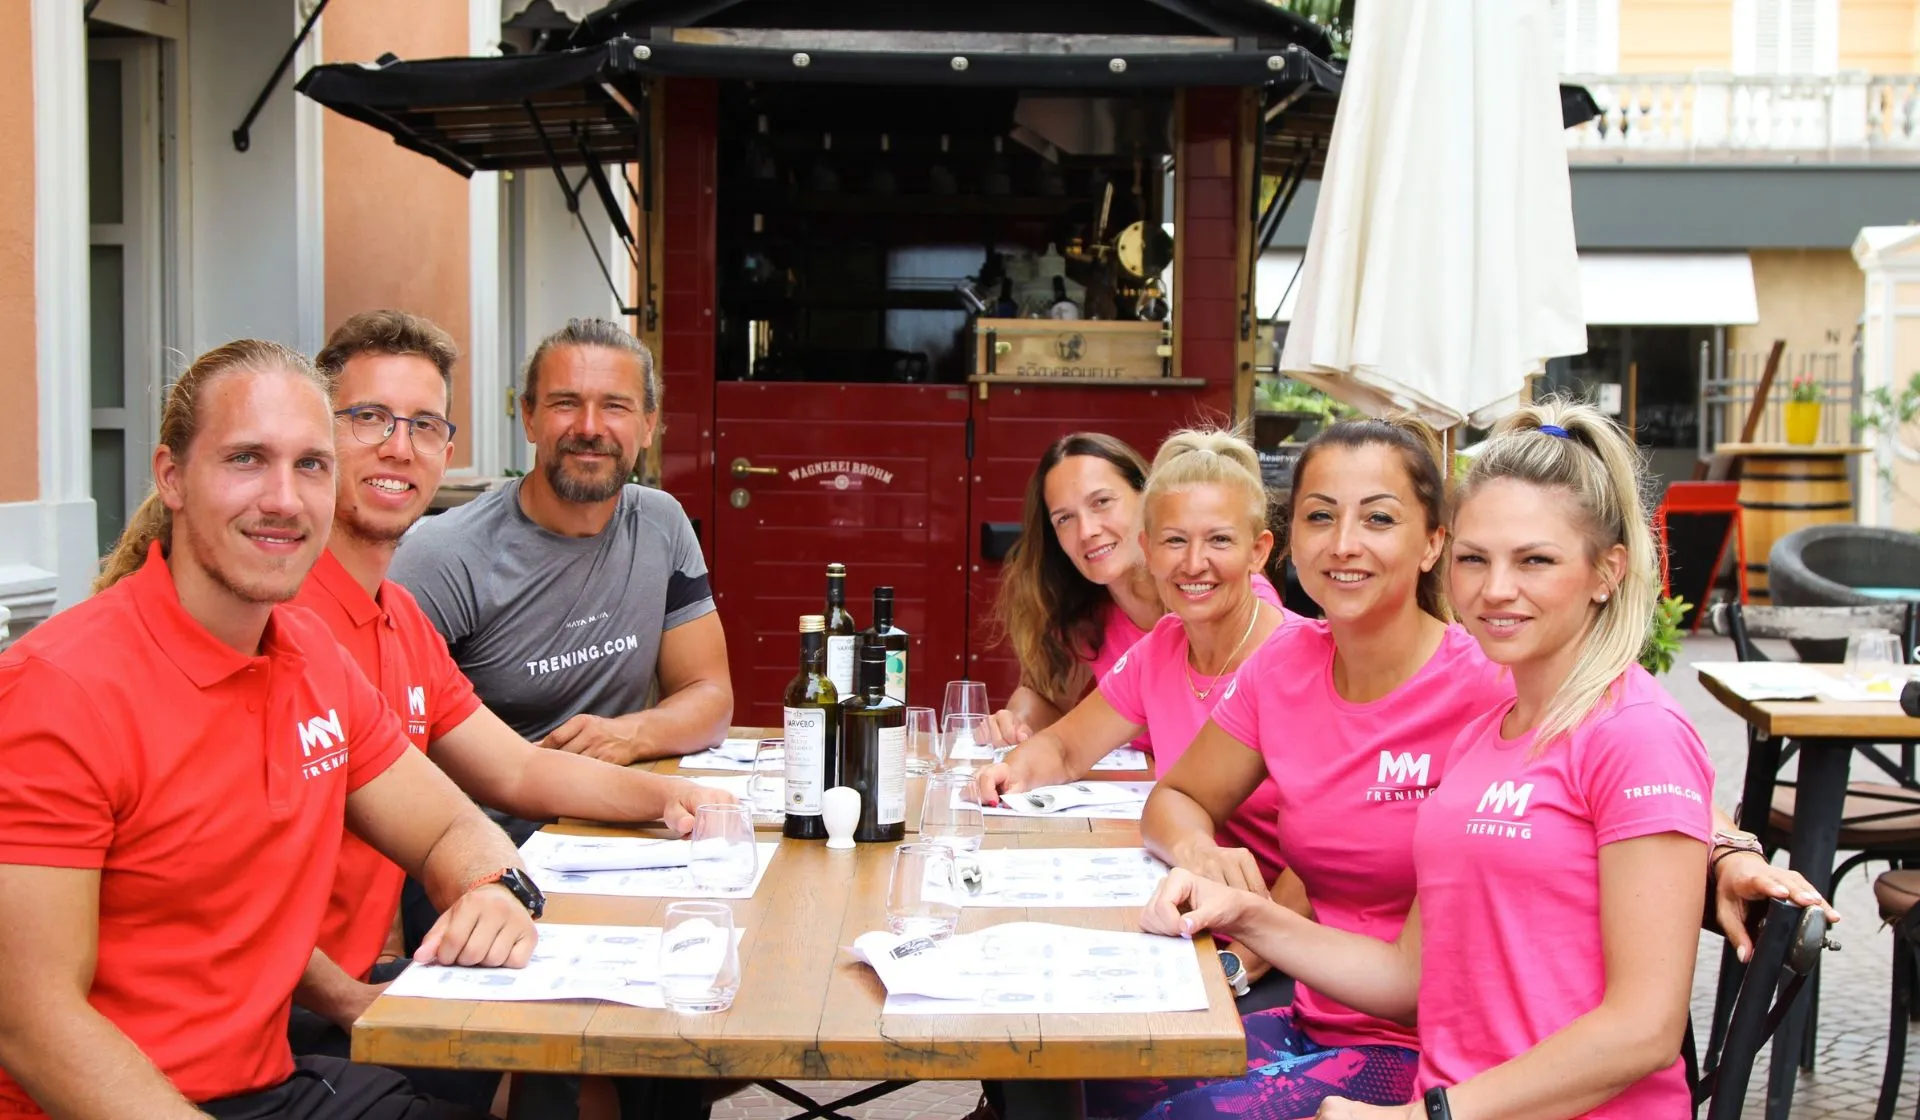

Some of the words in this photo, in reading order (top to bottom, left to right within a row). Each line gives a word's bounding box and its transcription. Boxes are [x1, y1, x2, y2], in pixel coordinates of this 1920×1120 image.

[788, 461, 850, 481] WAGNEREI
[852, 462, 894, 484] BROHM
[526, 634, 638, 676] TRENING.COM
[1377, 750, 1431, 786] MM
[1475, 780, 1535, 817] MM
[1466, 823, 1532, 840] TRENING
